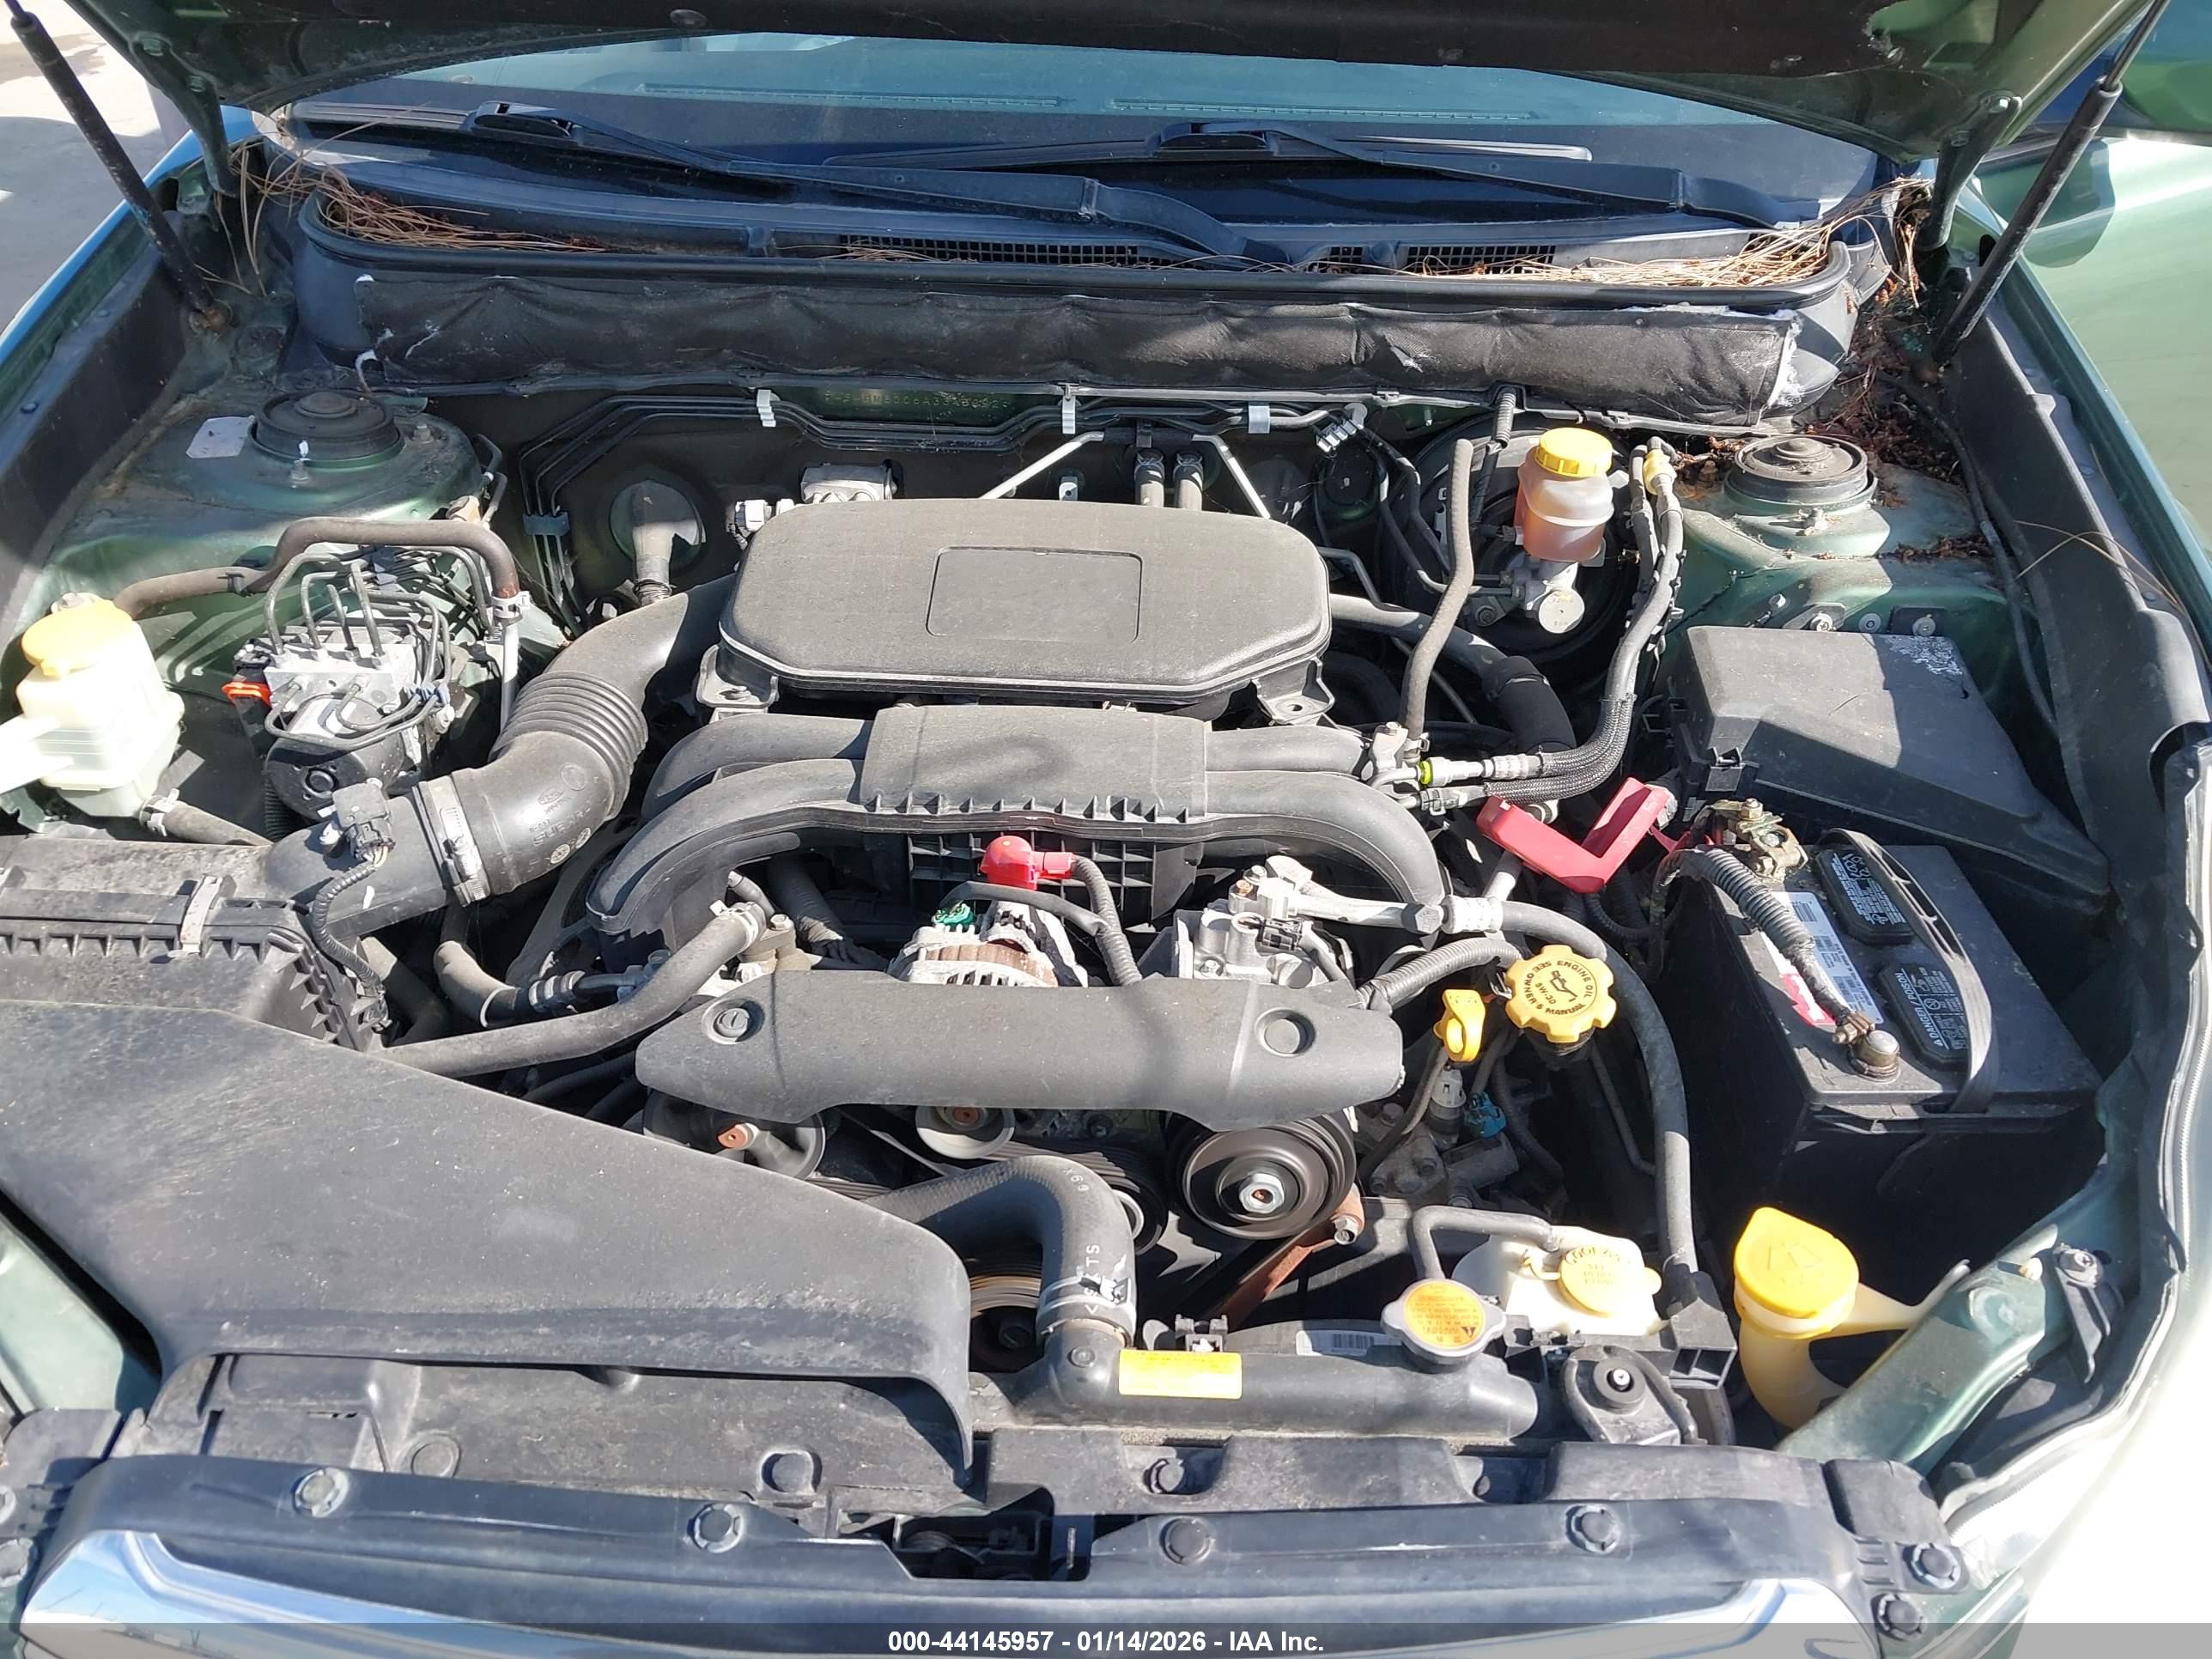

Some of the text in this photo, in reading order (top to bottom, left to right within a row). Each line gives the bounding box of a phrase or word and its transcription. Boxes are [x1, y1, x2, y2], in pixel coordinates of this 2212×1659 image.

[1532, 961, 1552, 973] SEE
[1545, 1003, 1586, 1015] MANUAL
[1557, 960, 1594, 999] ENGINE OIL
